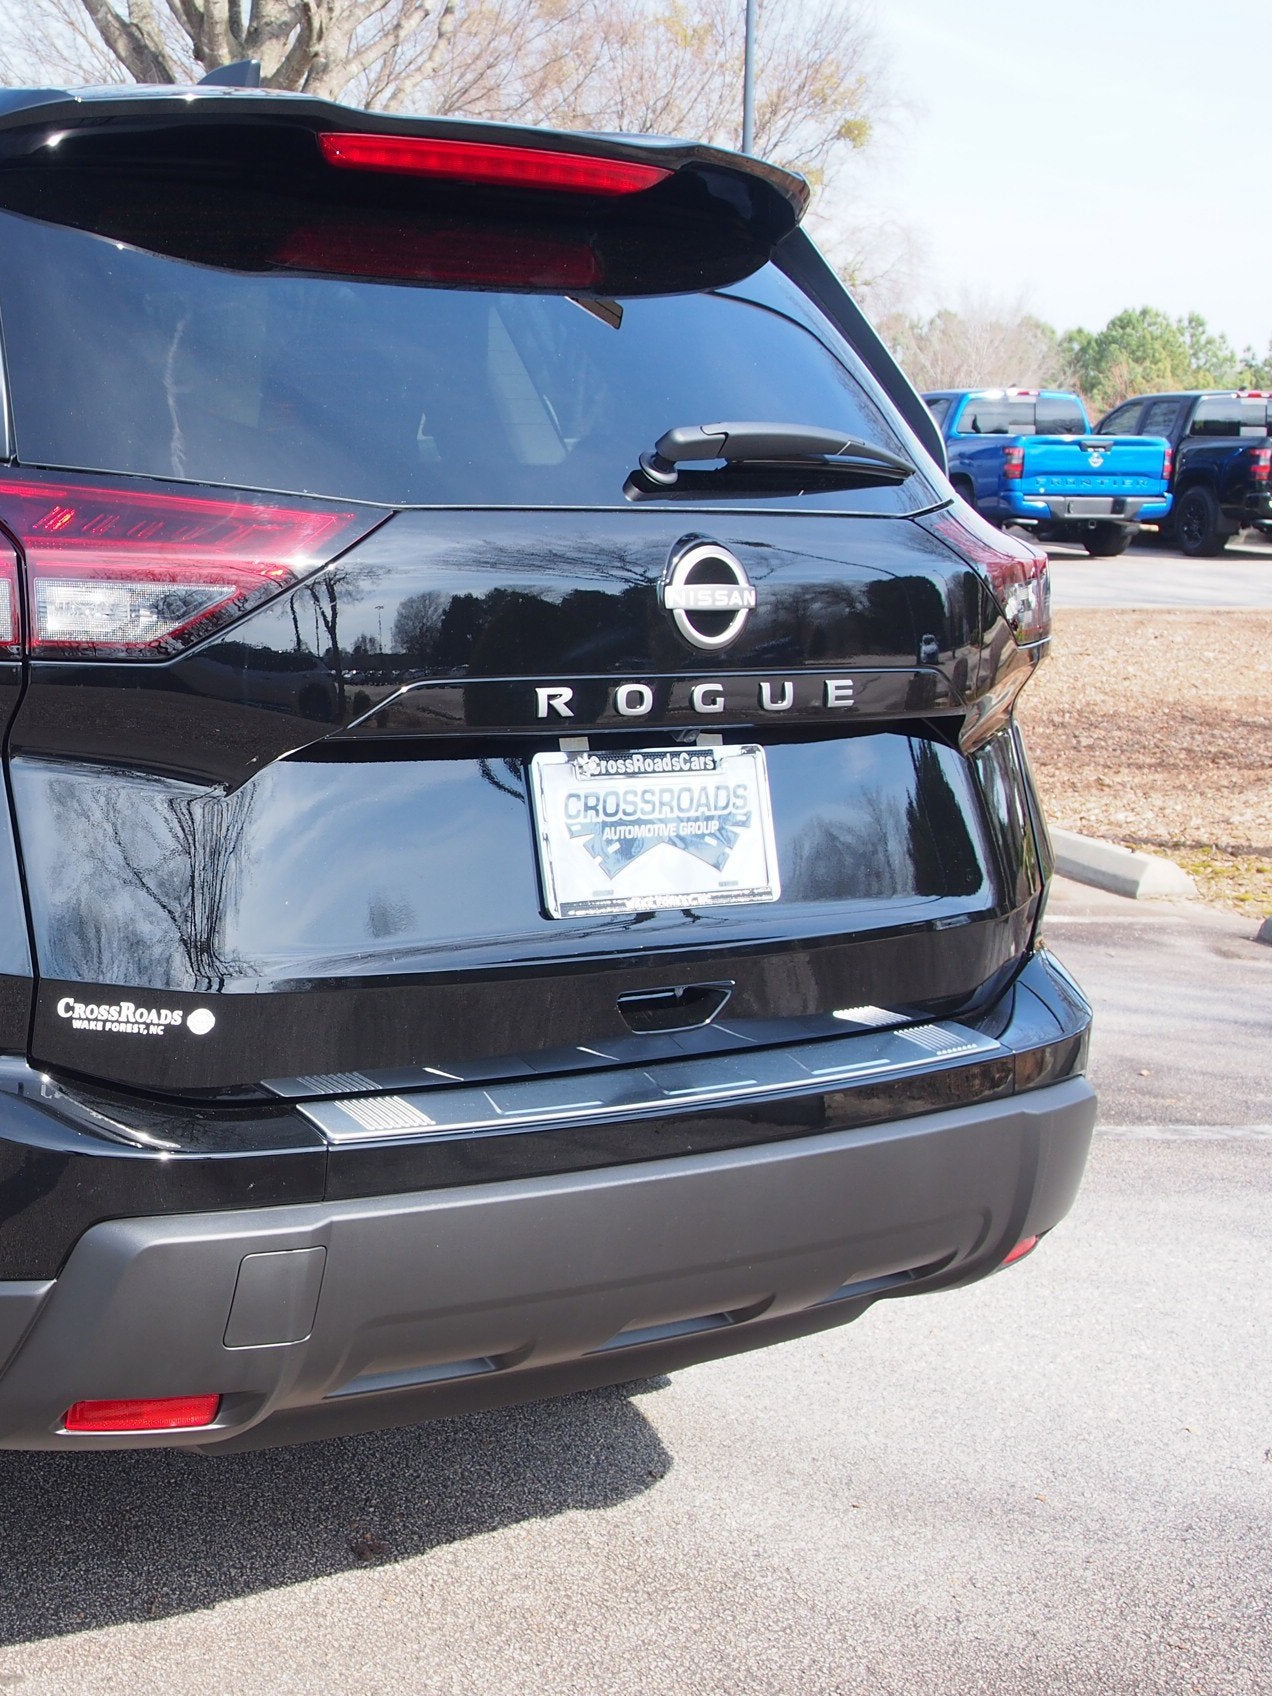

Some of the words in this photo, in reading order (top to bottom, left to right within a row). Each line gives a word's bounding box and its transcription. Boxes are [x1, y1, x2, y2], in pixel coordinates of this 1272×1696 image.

[1035, 478, 1149, 488] FRONTIER
[669, 590, 755, 606] NISSAN
[535, 679, 855, 719] ROGUE
[589, 751, 715, 776] CrossRoadsCars
[564, 783, 748, 820] CROSSROADS
[602, 823, 677, 841] AUTOMOTIVE
[679, 819, 720, 836] GROUP
[72, 1019, 103, 1031] WAKE
[105, 1021, 148, 1035] FOREST,
[149, 1025, 166, 1035] NC
